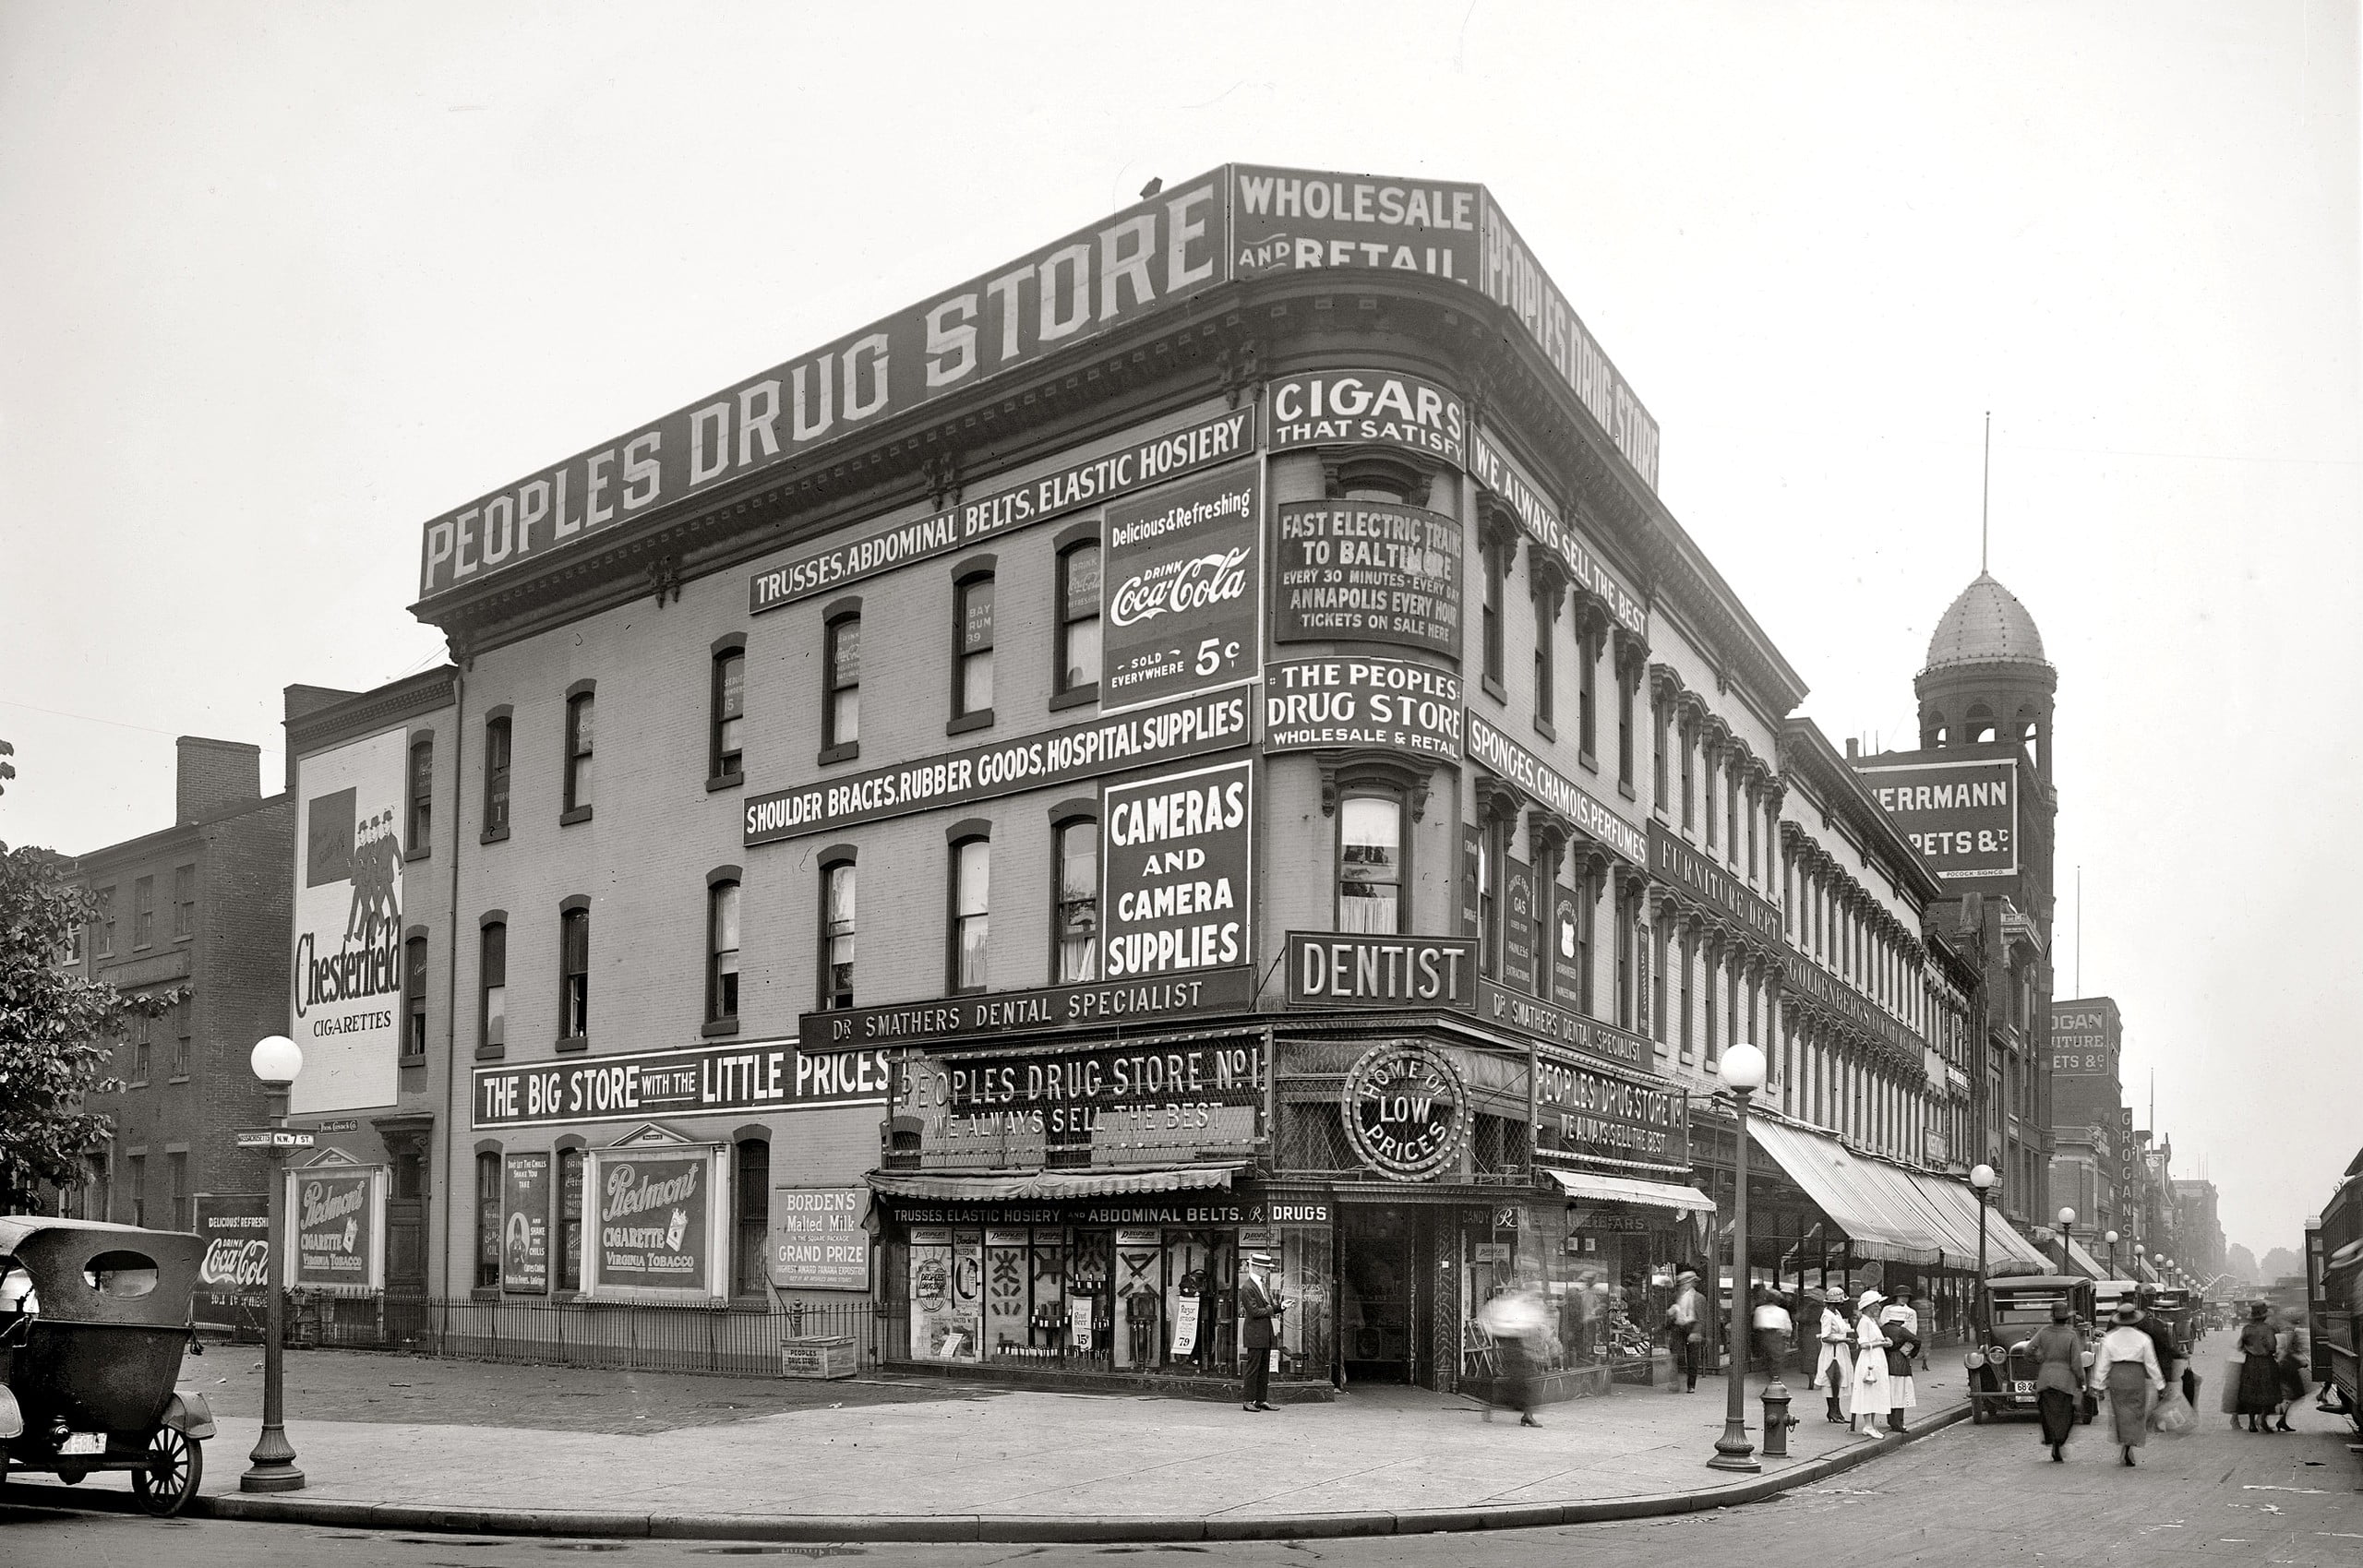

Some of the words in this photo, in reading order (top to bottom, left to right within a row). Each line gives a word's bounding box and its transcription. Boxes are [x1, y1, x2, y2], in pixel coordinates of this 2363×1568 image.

[1240, 175, 1473, 231] WHOLESALE
[1240, 242, 1290, 267] AND
[1295, 237, 1468, 284] RETAIL
[423, 430, 661, 588] PEOPLES
[688, 332, 888, 488] DRUG
[925, 185, 1215, 386] STORE
[1276, 377, 1462, 440] CIGARS
[1277, 420, 1354, 444] THAT
[1360, 419, 1463, 461] SATISFY
[846, 513, 958, 574] ABDOMINAL
[966, 487, 1035, 538] BELTS,
[1039, 456, 1132, 513] ELASTIC
[1140, 414, 1241, 479] HOSIERY
[1112, 517, 1167, 548] Delicious
[1176, 488, 1253, 527] Refreshing
[1282, 511, 1328, 540] FAST
[1332, 511, 1421, 544] ELECTRIC
[1425, 521, 1462, 559] TRAINS
[1476, 438, 1500, 491] WE
[1505, 472, 1558, 548] ALWAYS
[1562, 533, 1591, 586] SELL
[1593, 565, 1615, 611] THE
[1619, 591, 1645, 636] BEST
[1144, 560, 1182, 581] DRINK
[1302, 541, 1330, 565] TO
[1340, 540, 1452, 581] BALTIMORE
[1110, 545, 1252, 627] Coca-Cola
[1283, 569, 1318, 585] EVERY
[1324, 569, 1342, 583] 30
[1413, 577, 1445, 597] EVERY
[1446, 584, 1460, 602] DAY
[968, 604, 991, 618] BAY
[968, 617, 992, 631] RUM
[1290, 588, 1387, 610] ANNAPOLIS
[1392, 592, 1433, 617] EVERY
[1435, 600, 1457, 628] HOUR
[1301, 614, 1362, 628] TICKETS
[1368, 615, 1388, 629] ON
[1393, 616, 1424, 635] SALE
[1428, 624, 1449, 642] HERE
[966, 632, 981, 644] 39
[1111, 661, 1184, 688] EVERYWHERE
[1132, 652, 1161, 668] SOLD
[1281, 664, 1341, 688] THE
[1349, 664, 1457, 700] PEOPLES
[1267, 692, 1356, 727] DRUG
[1370, 694, 1460, 740] STORE
[1274, 728, 1386, 745] WHOLESALE
[1394, 732, 1406, 745] &
[1411, 734, 1458, 759] RETAIL
[747, 791, 822, 834] SHOULDER
[828, 774, 899, 818] BRACES,
[900, 760, 972, 803] RUBBER
[978, 743, 1046, 786] GOODS,
[1047, 722, 1142, 772] HOSPITAL
[1143, 699, 1244, 748] SUPPLIES
[1472, 719, 1536, 791] SPONGES,
[1591, 810, 1646, 864] PERFUMES
[1110, 782, 1244, 847] CAMERAS
[1142, 848, 1205, 877] AND
[1661, 839, 1744, 918] FURNITURE
[1118, 878, 1234, 922] CAMERA
[1514, 897, 1526, 915] GAS
[294, 914, 402, 1019] Chesterfield
[1108, 922, 1240, 976] SUPPLIES
[1303, 942, 1466, 1000] DENTIST
[866, 1007, 960, 1039] SMATHERS
[977, 997, 1052, 1027] DENTAL
[1068, 980, 1203, 1020] SPECIALIST
[1789, 957, 1870, 1027] GOLDENBERG'S
[312, 1010, 391, 1037] CIGARETTES
[1511, 999, 1558, 1036] SMATHERS
[1563, 1018, 1592, 1048] DENTAL
[1596, 1029, 1641, 1062] SPECIALIST
[484, 1076, 518, 1118] THE
[528, 1072, 562, 1115] BIG
[570, 1066, 640, 1110] STORE
[642, 1074, 671, 1096] WITH
[673, 1071, 696, 1094] THE
[702, 1051, 784, 1103] LITTLE
[797, 1048, 890, 1096] PRICES
[902, 1066, 1015, 1107] PEOPLES
[1027, 1060, 1102, 1101] DRUG
[1113, 1051, 1203, 1095] STORE
[1361, 1060, 1423, 1100] HOME
[1424, 1073, 1448, 1097] OF
[1535, 1061, 1596, 1110] PEOPLES
[1602, 1079, 1634, 1119] DRUG
[1635, 1087, 1668, 1126] STORE
[932, 1114, 958, 1139] WE
[967, 1107, 1044, 1138] ALWAYS
[1051, 1106, 1105, 1133] SELL
[1117, 1102, 1157, 1131] THE
[1166, 1101, 1224, 1130] BEST
[1380, 1095, 1433, 1124] LOW
[1365, 1120, 1446, 1161] PRICES
[1560, 1114, 1575, 1140] WE
[1576, 1116, 1609, 1145] ALWAYS
[1609, 1123, 1632, 1149] SELL
[1632, 1128, 1647, 1151] THE
[1647, 1130, 1666, 1154] BEST
[300, 1180, 366, 1230] Piedmont
[603, 1163, 699, 1222] Piedmont
[786, 1191, 856, 1211] BORDEN'S
[530, 1227, 546, 1236] SHAKE
[786, 1215, 822, 1232] Malted
[829, 1215, 855, 1232] Milk
[894, 1208, 945, 1224] TRUSSES,
[947, 1208, 999, 1223] ELASTIC
[1004, 1208, 1061, 1223] HOSIERY
[1088, 1208, 1181, 1223] ABDOMINAL
[1187, 1207, 1243, 1222] BELTS.
[1274, 1206, 1326, 1221] DRUGS
[1462, 1211, 1490, 1225] CANDY
[222, 1239, 244, 1248] DRINK
[300, 1234, 342, 1251] CIGARETTE
[529, 1247, 546, 1256] CHILLS
[603, 1227, 665, 1249] CIGARETTE
[778, 1245, 822, 1263] GRAND
[826, 1245, 864, 1263] PRIZE
[808, 1235, 825, 1243] SQUARE
[303, 1253, 330, 1266] VIRGINIA
[330, 1253, 362, 1267] TOBACCO
[606, 1251, 646, 1267] VIRGINIA
[647, 1252, 694, 1270] TOBACCO
[1302, 1294, 1324, 1302] STORE
